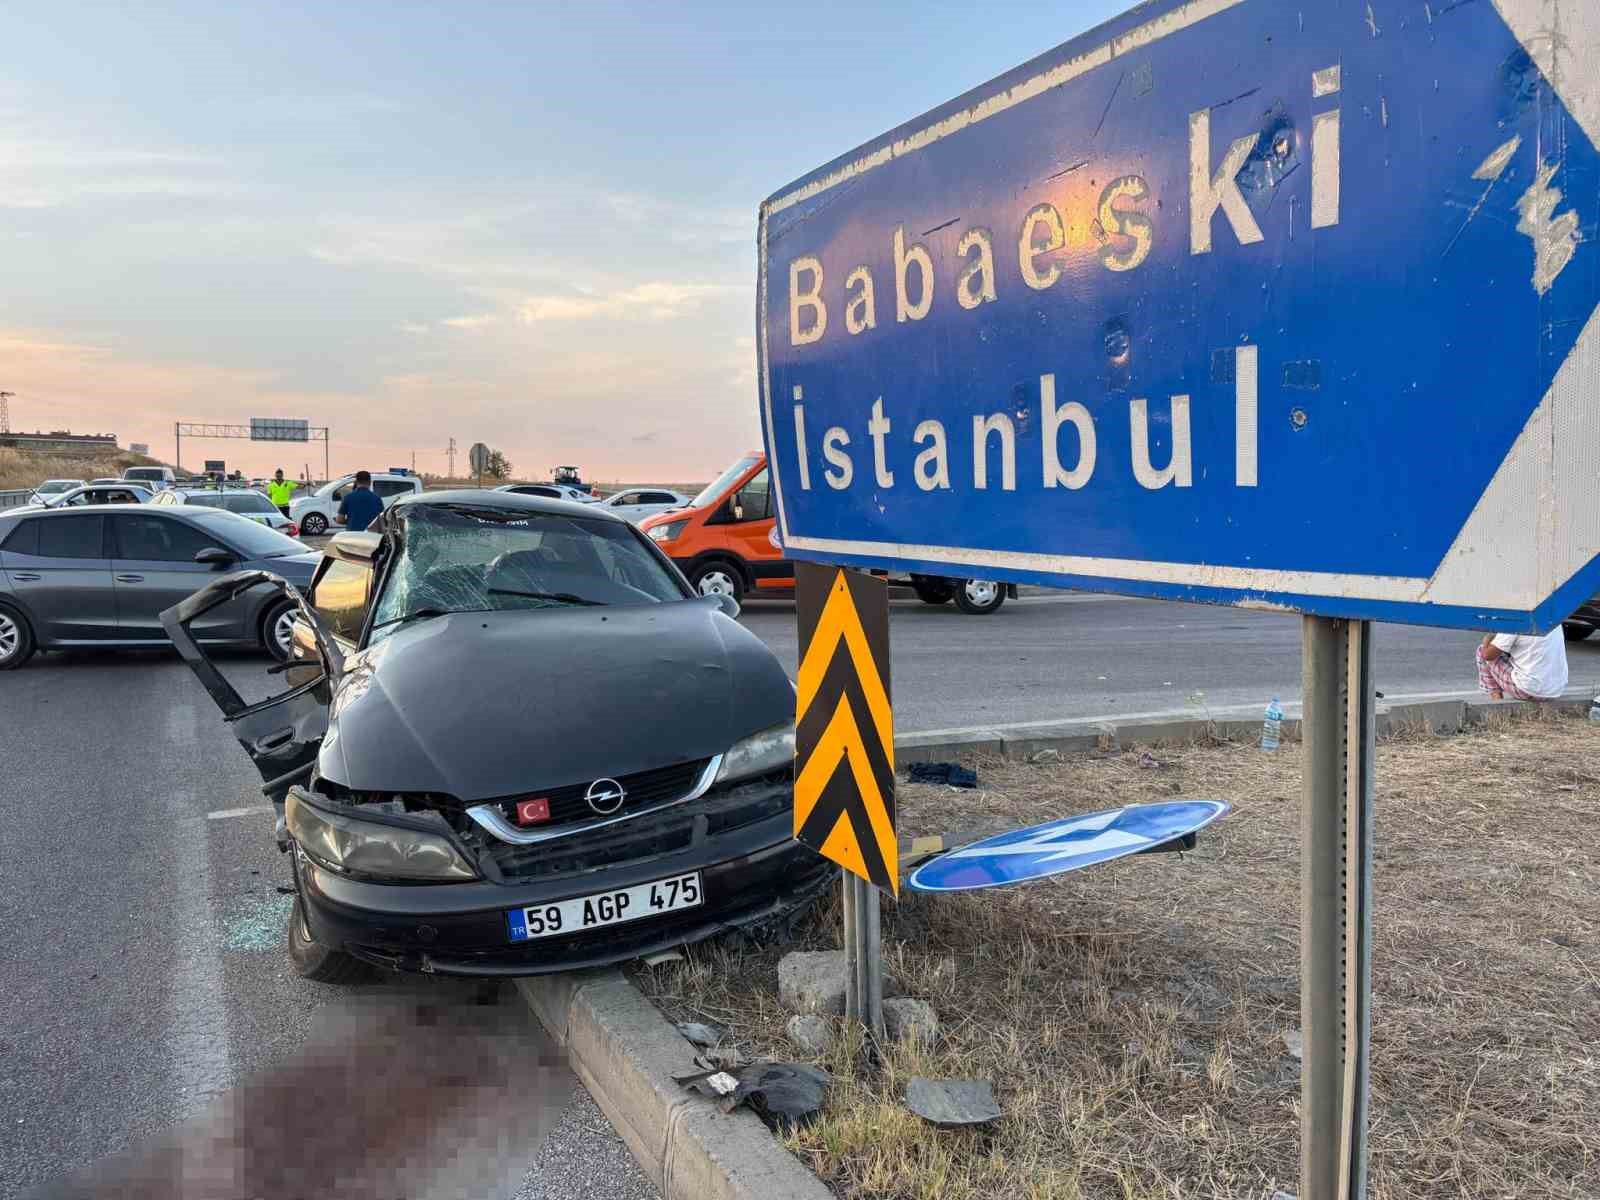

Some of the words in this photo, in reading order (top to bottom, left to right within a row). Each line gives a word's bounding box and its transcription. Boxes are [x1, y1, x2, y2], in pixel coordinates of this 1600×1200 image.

[789, 65, 1341, 346] Babaeski
[511, 927, 526, 937] TR
[527, 907, 562, 934] 59
[583, 892, 630, 926] AGP
[650, 876, 698, 910] 475
